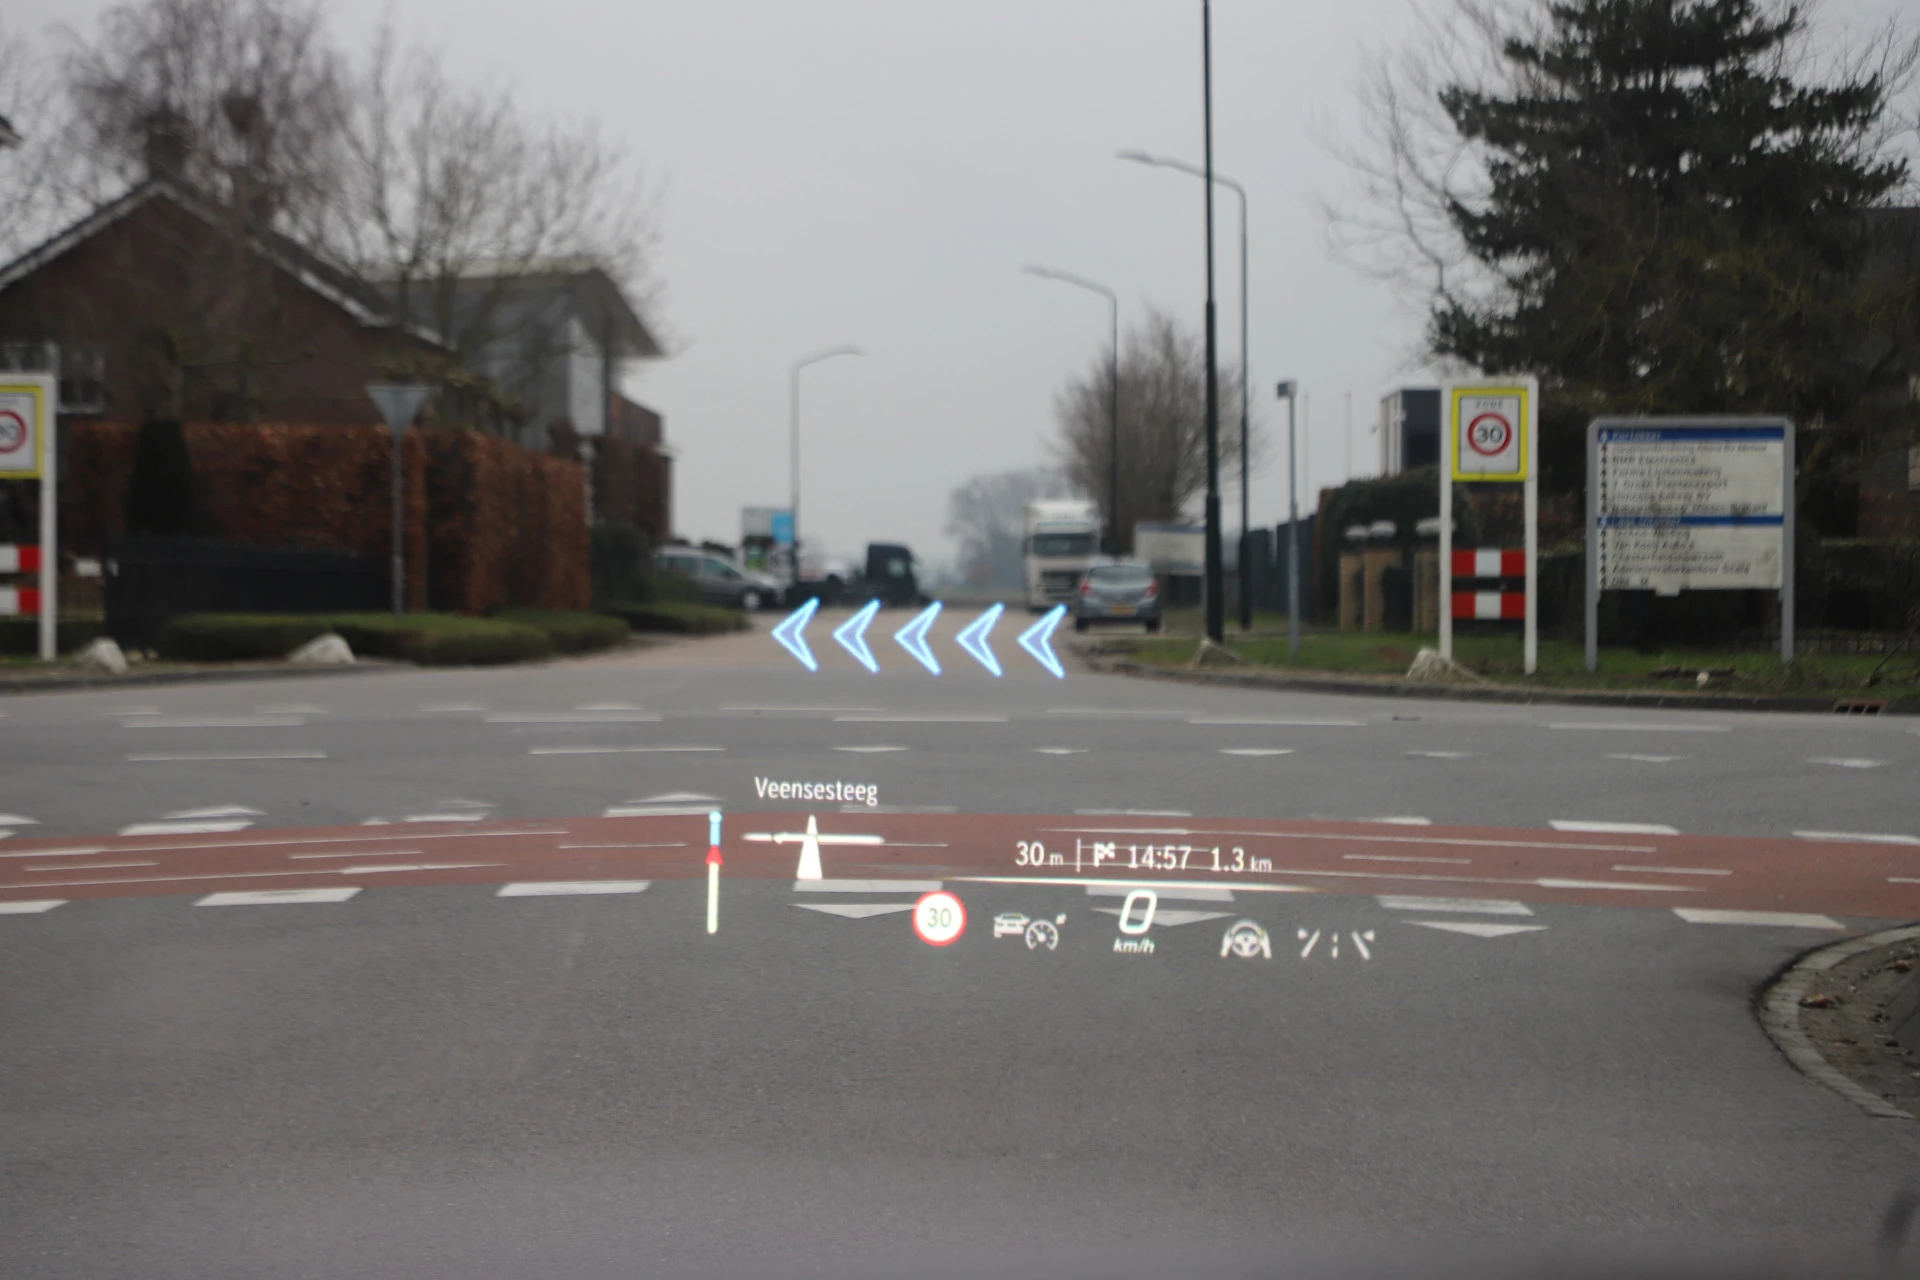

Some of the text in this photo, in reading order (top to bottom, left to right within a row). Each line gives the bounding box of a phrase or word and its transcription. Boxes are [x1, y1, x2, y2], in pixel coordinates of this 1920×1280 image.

[1476, 424, 1504, 445] 30
[754, 776, 878, 807] Veensesteeg
[1015, 841, 1272, 872] 30 m 14:57 1.3 km
[926, 907, 953, 928] 30
[1119, 889, 1158, 935] 0
[1112, 937, 1156, 955] km/h
